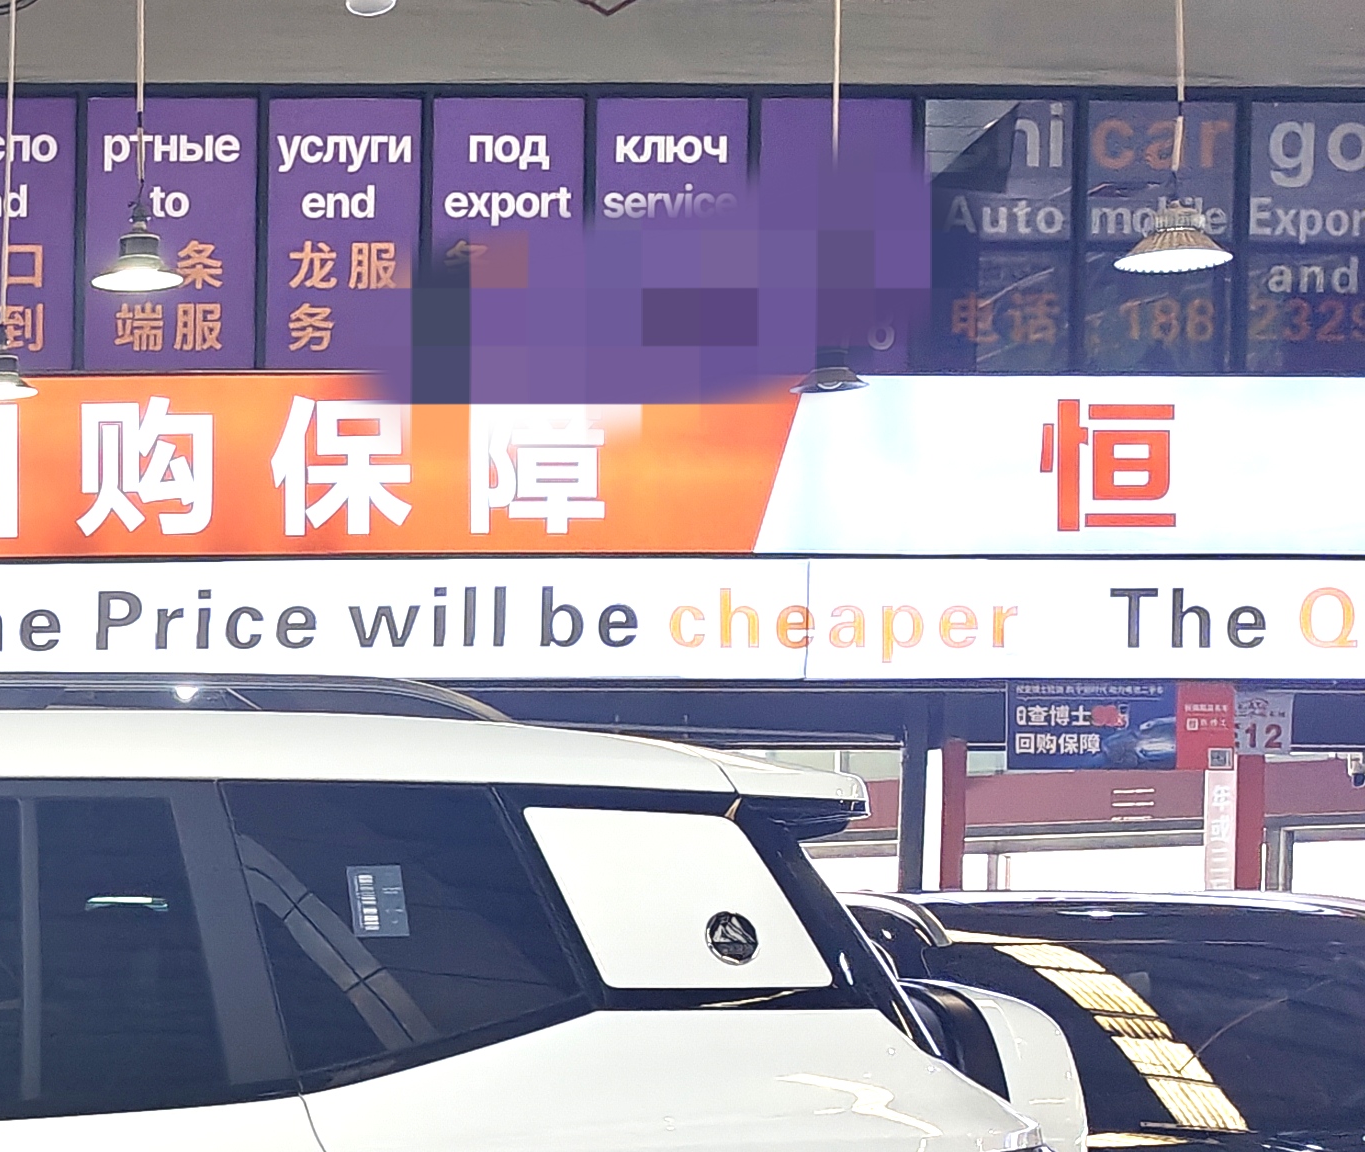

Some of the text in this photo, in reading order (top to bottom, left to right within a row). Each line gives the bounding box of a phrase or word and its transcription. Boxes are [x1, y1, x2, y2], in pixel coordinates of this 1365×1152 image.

[103, 131, 241, 171] ртные
[277, 133, 412, 172] услуги
[469, 135, 550, 170] под
[615, 135, 729, 164] ключ
[1092, 118, 1231, 169] car
[1269, 121, 1365, 187] go
[150, 186, 190, 218] to
[302, 184, 376, 218] end
[444, 186, 572, 227] export
[944, 195, 1066, 234] Auto
[1268, 256, 1360, 294] and
[1039, 398, 1177, 532] 恒
[96, 590, 318, 653] Price
[349, 586, 506, 650] will
[542, 587, 639, 649] be
[669, 587, 1019, 663] cheaper
[1110, 587, 1267, 648] The
[1015, 733, 1101, 755] 回购保障
[1235, 723, 1283, 749] 12
